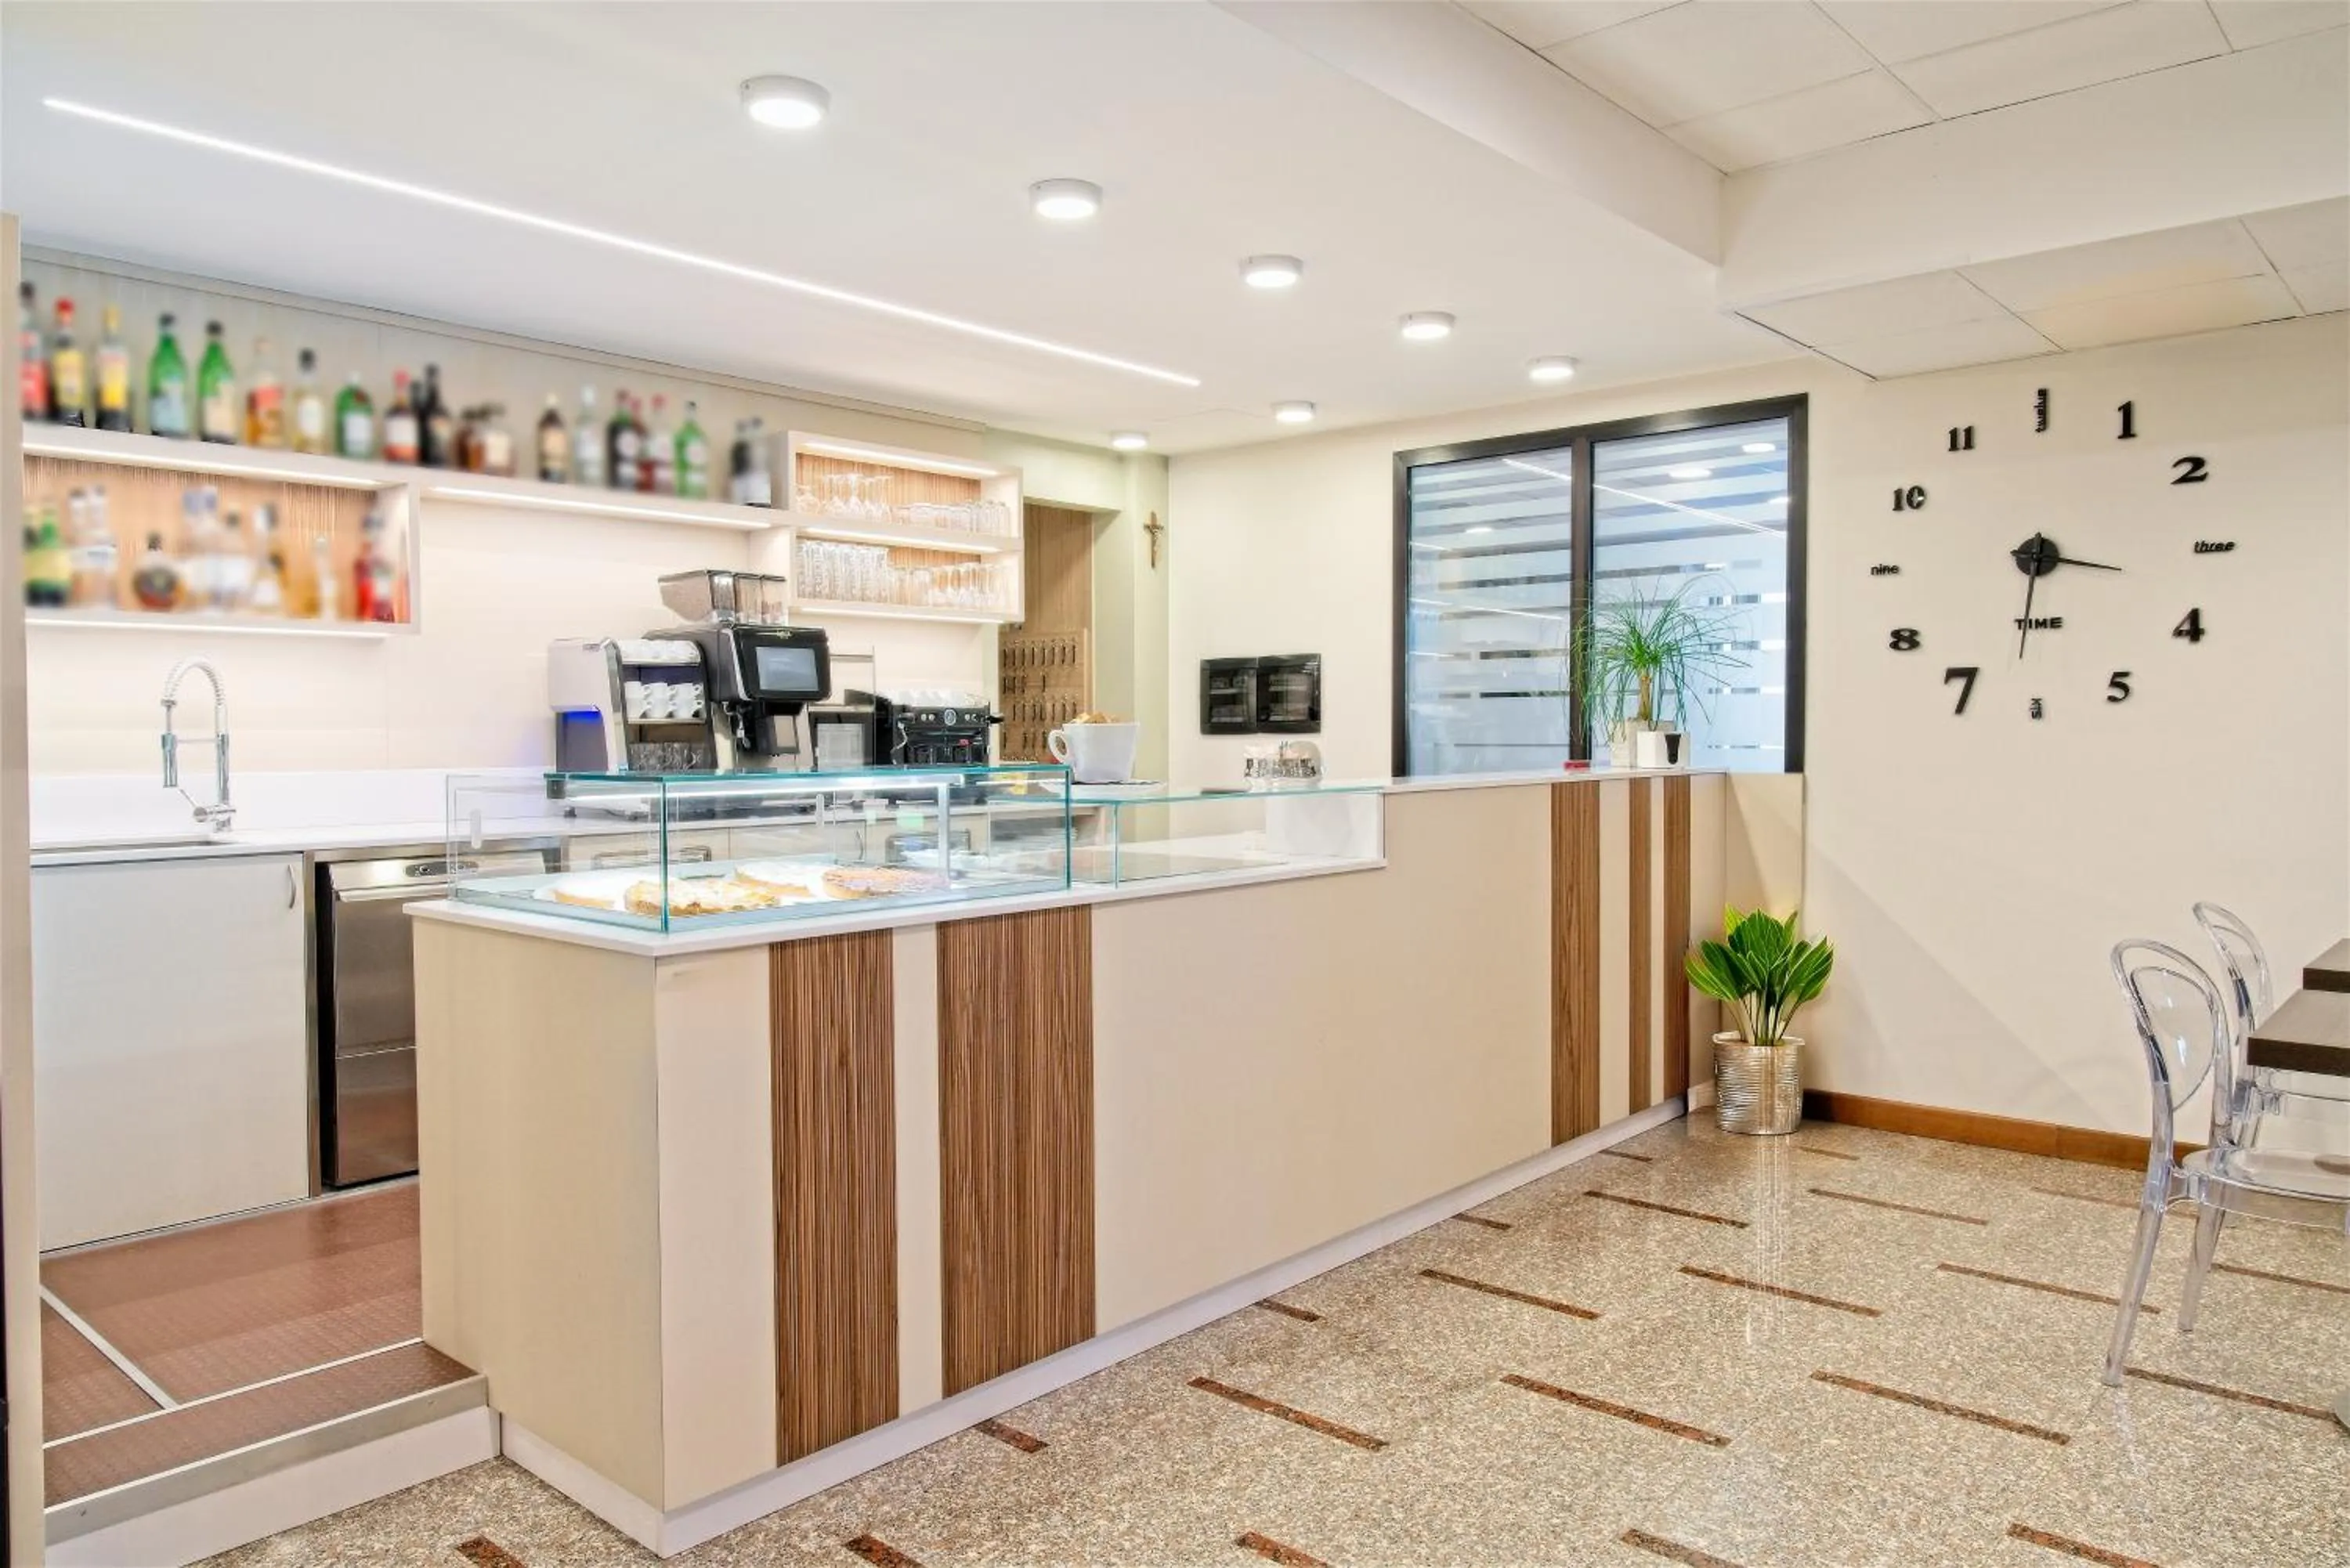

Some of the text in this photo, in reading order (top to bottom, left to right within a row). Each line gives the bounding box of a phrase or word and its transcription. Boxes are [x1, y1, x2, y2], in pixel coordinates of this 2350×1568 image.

[2117, 401, 2137, 439] 1
[1948, 426, 1975, 451] 11
[2171, 456, 2208, 484] 2
[1893, 486, 1925, 511] 10
[2194, 540, 2235, 554] three
[1871, 564, 1900, 576] nine
[2014, 617, 2063, 630] TIME
[2172, 608, 2205, 643] 4
[1889, 628, 1920, 651] 8
[1944, 667, 1979, 715] 7
[2107, 671, 2131, 703] 5
[2030, 699, 2042, 720] six
